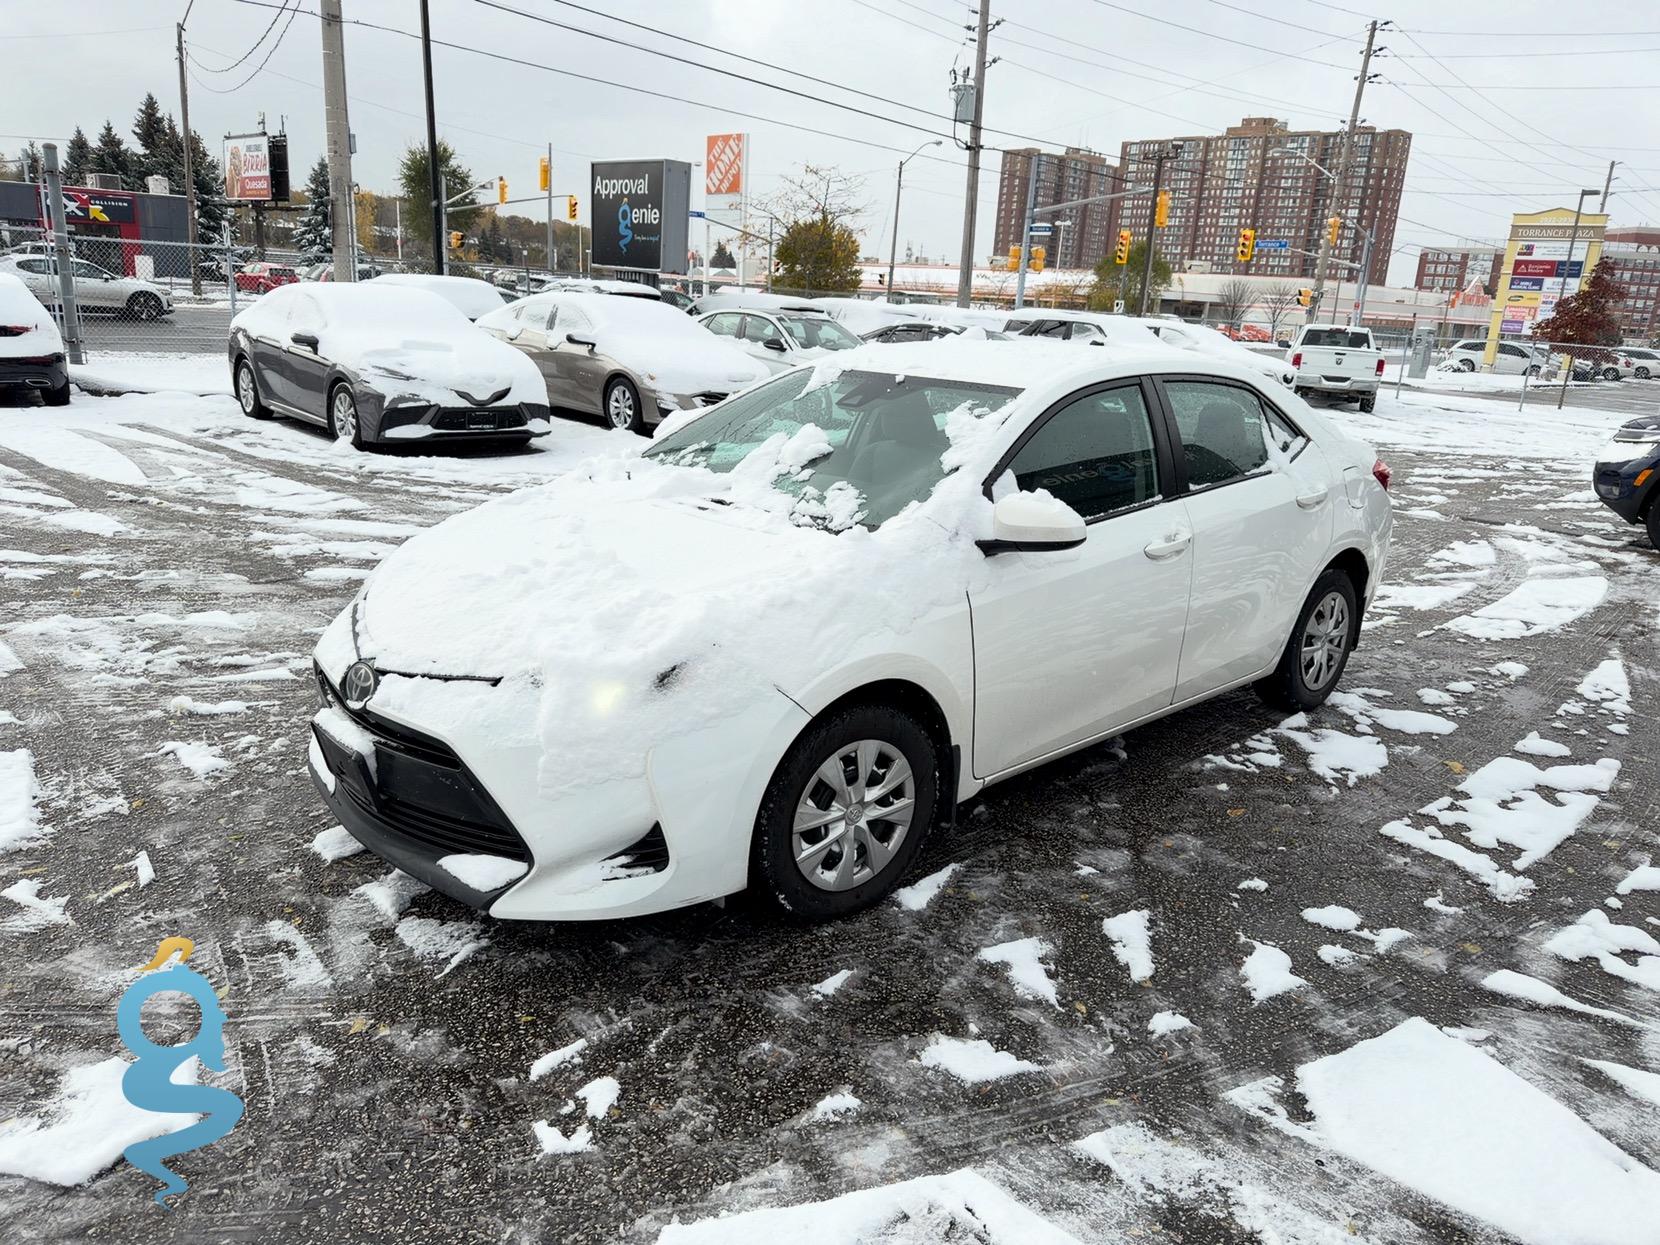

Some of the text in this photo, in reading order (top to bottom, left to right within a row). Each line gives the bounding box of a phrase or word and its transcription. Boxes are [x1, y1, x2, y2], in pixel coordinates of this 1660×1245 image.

[709, 138, 725, 163] THE
[706, 135, 742, 193] HOME
[720, 157, 742, 193] DEPOT
[244, 178, 268, 190] Quesada
[594, 174, 648, 199] Approval
[618, 198, 660, 256] genie
[1518, 229, 1594, 238] TORRANCE PAZA
